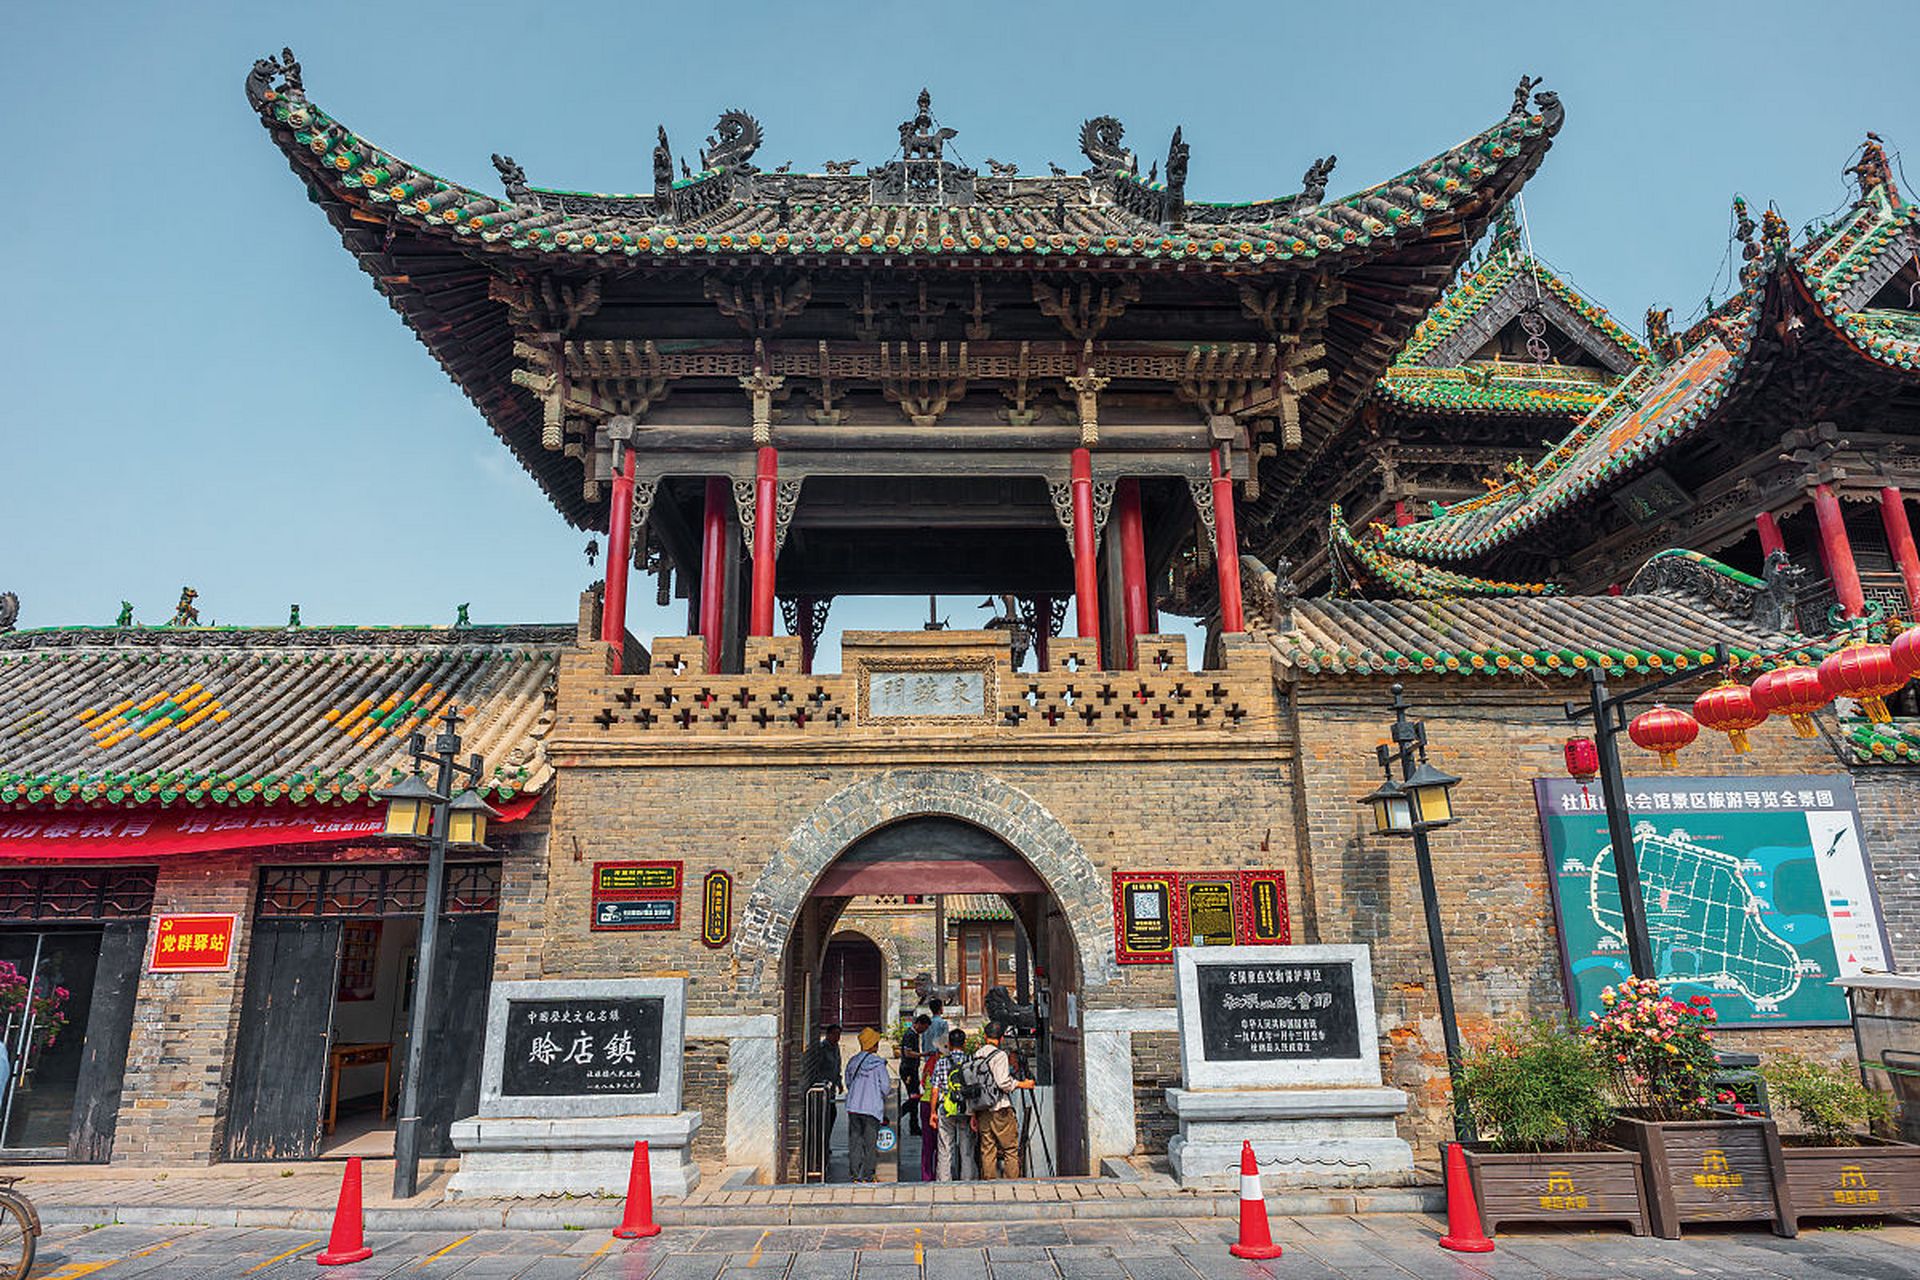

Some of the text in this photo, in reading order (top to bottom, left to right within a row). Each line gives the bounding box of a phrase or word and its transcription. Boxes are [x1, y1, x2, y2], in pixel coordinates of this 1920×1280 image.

[161, 934, 225, 952] 党群驿站
[1229, 969, 1322, 985] 全国重点文物保护单位
[528, 1030, 637, 1065] 賒店鎮
